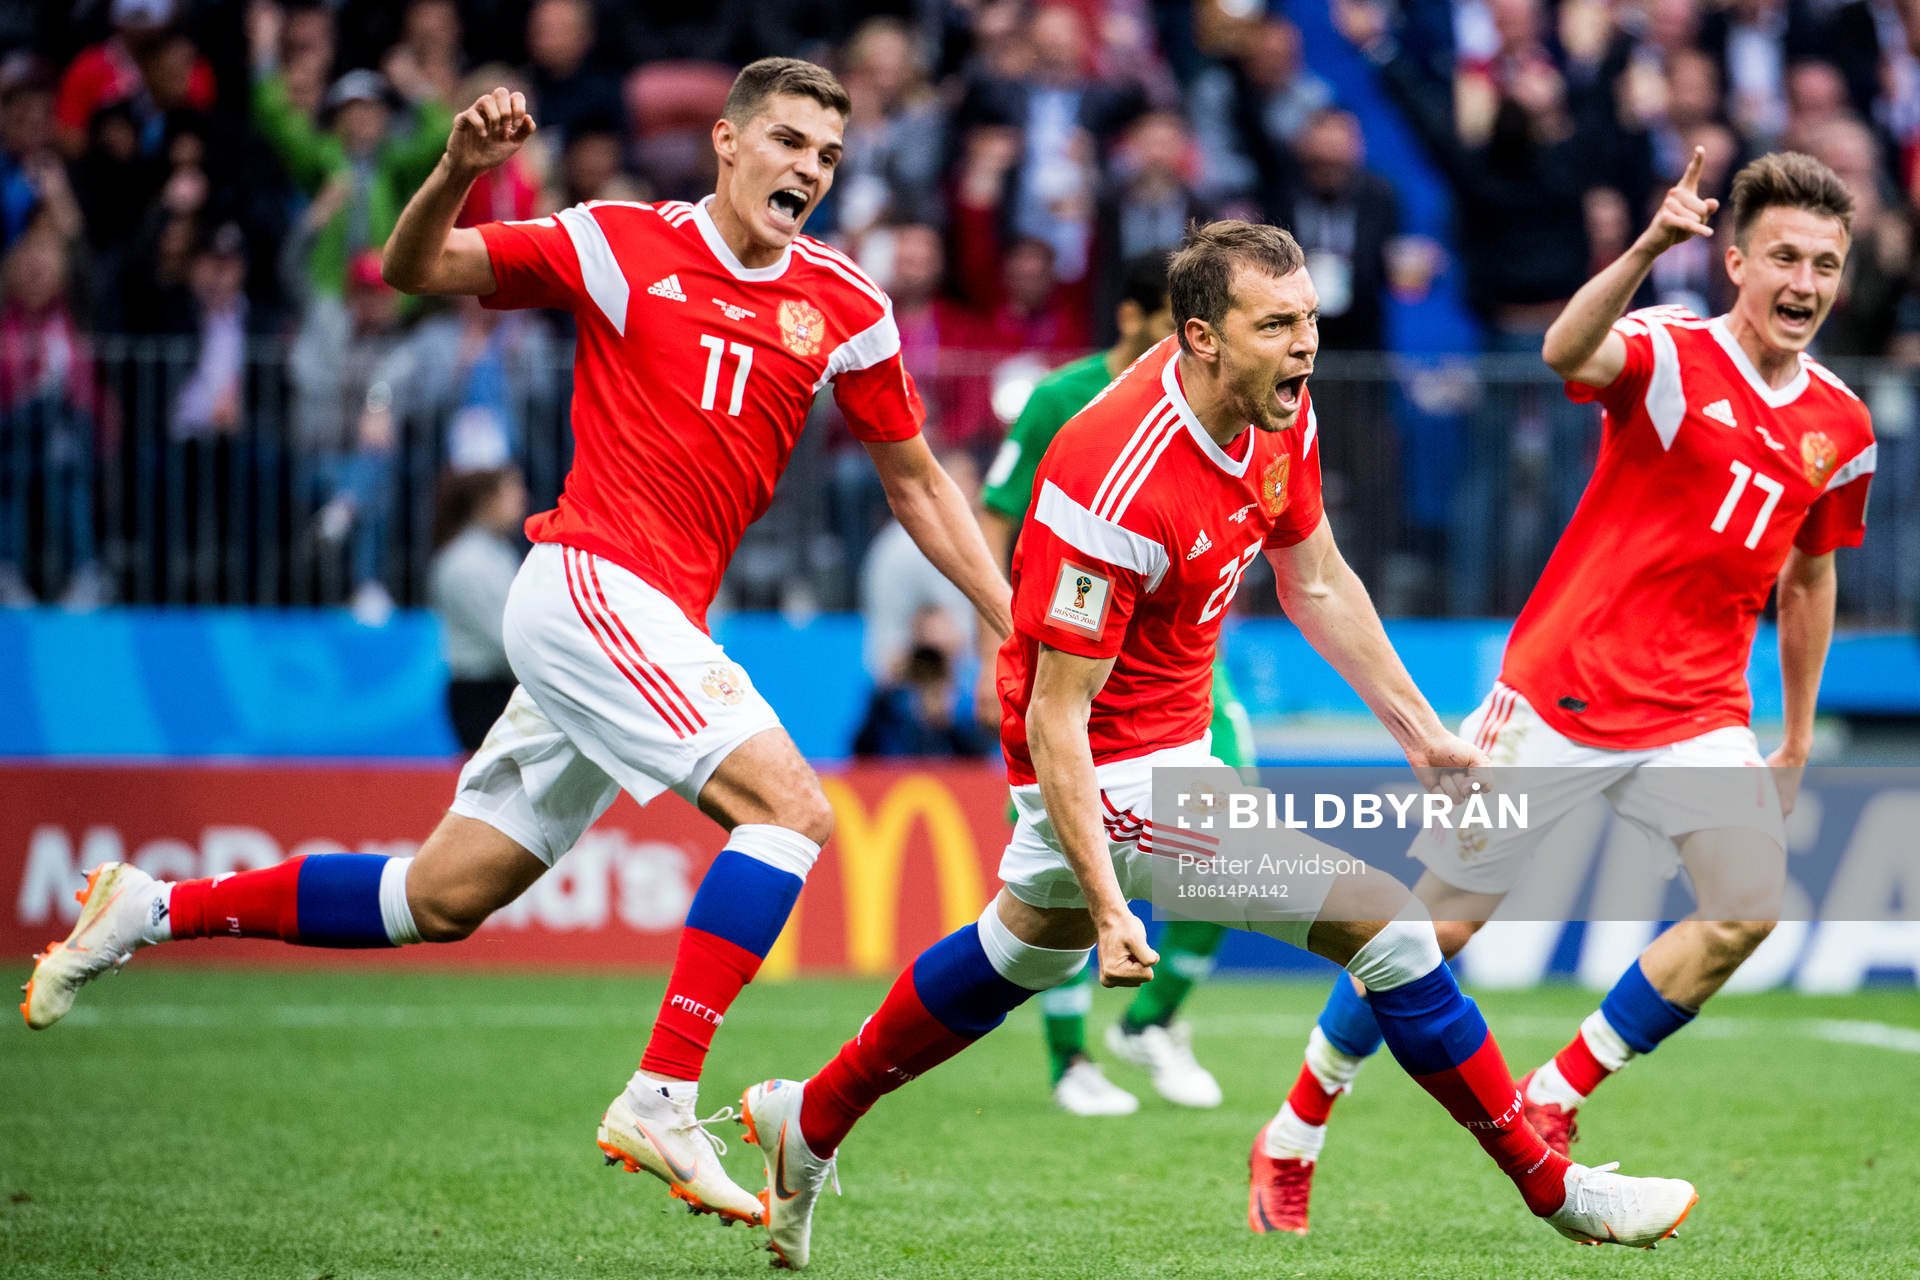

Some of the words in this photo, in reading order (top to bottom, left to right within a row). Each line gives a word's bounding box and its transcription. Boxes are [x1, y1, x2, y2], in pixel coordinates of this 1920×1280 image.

[647, 286, 687, 303] adidas
[700, 333, 754, 417] 11
[1710, 459, 1785, 551] 17
[1186, 540, 1213, 561] adidas
